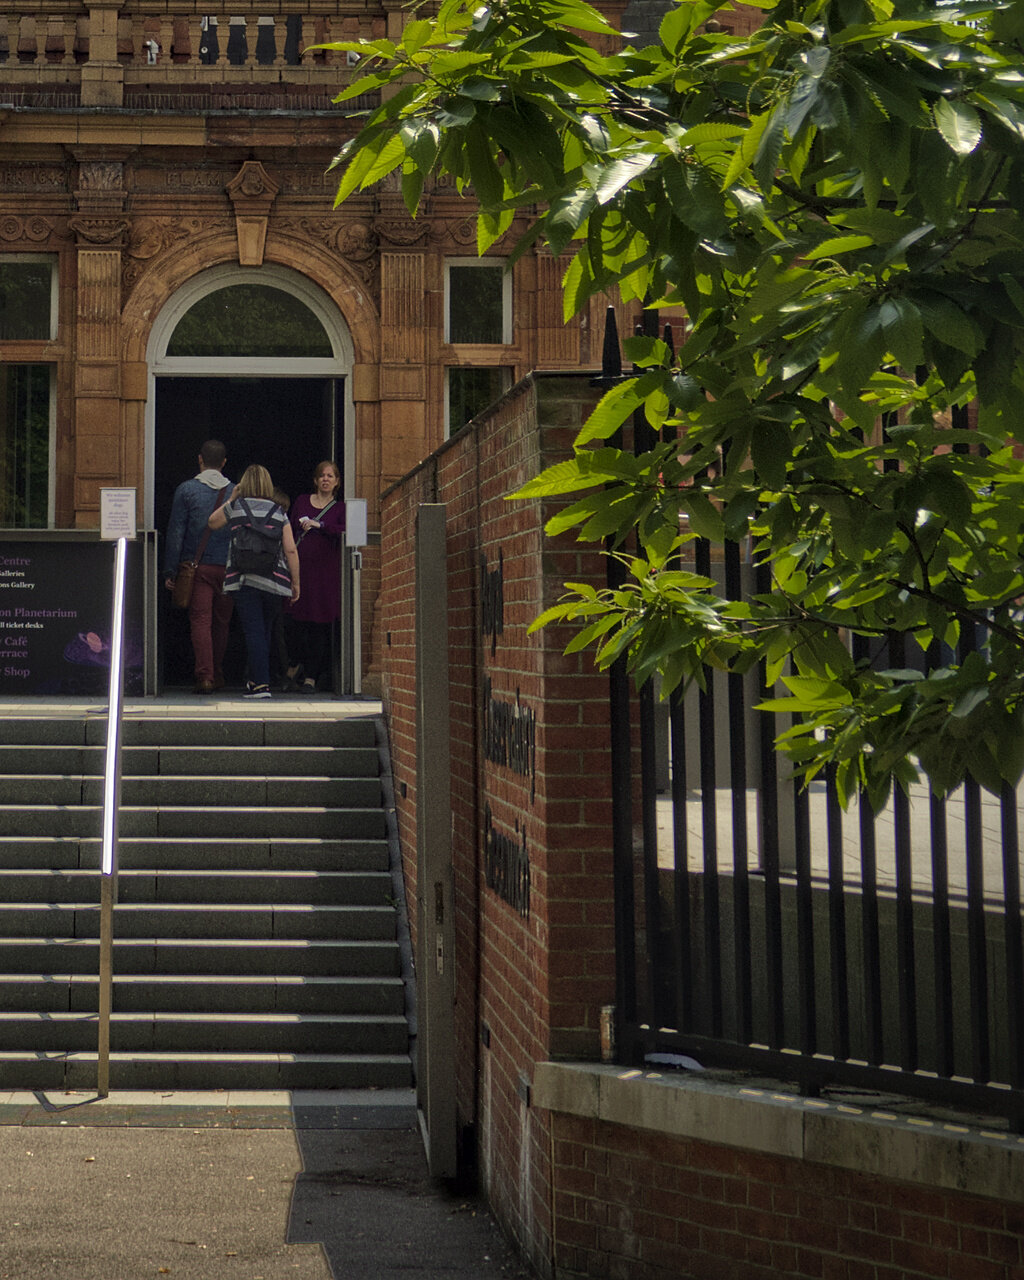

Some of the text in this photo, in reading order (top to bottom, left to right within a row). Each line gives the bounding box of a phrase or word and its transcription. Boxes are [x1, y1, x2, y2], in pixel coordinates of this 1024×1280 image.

[166, 171, 344, 187] FLAM STEE
[11, 581, 35, 590] Gallery
[14, 608, 77, 618] Planetarium
[4, 636, 28, 646] Café
[4, 666, 30, 678] Shop
